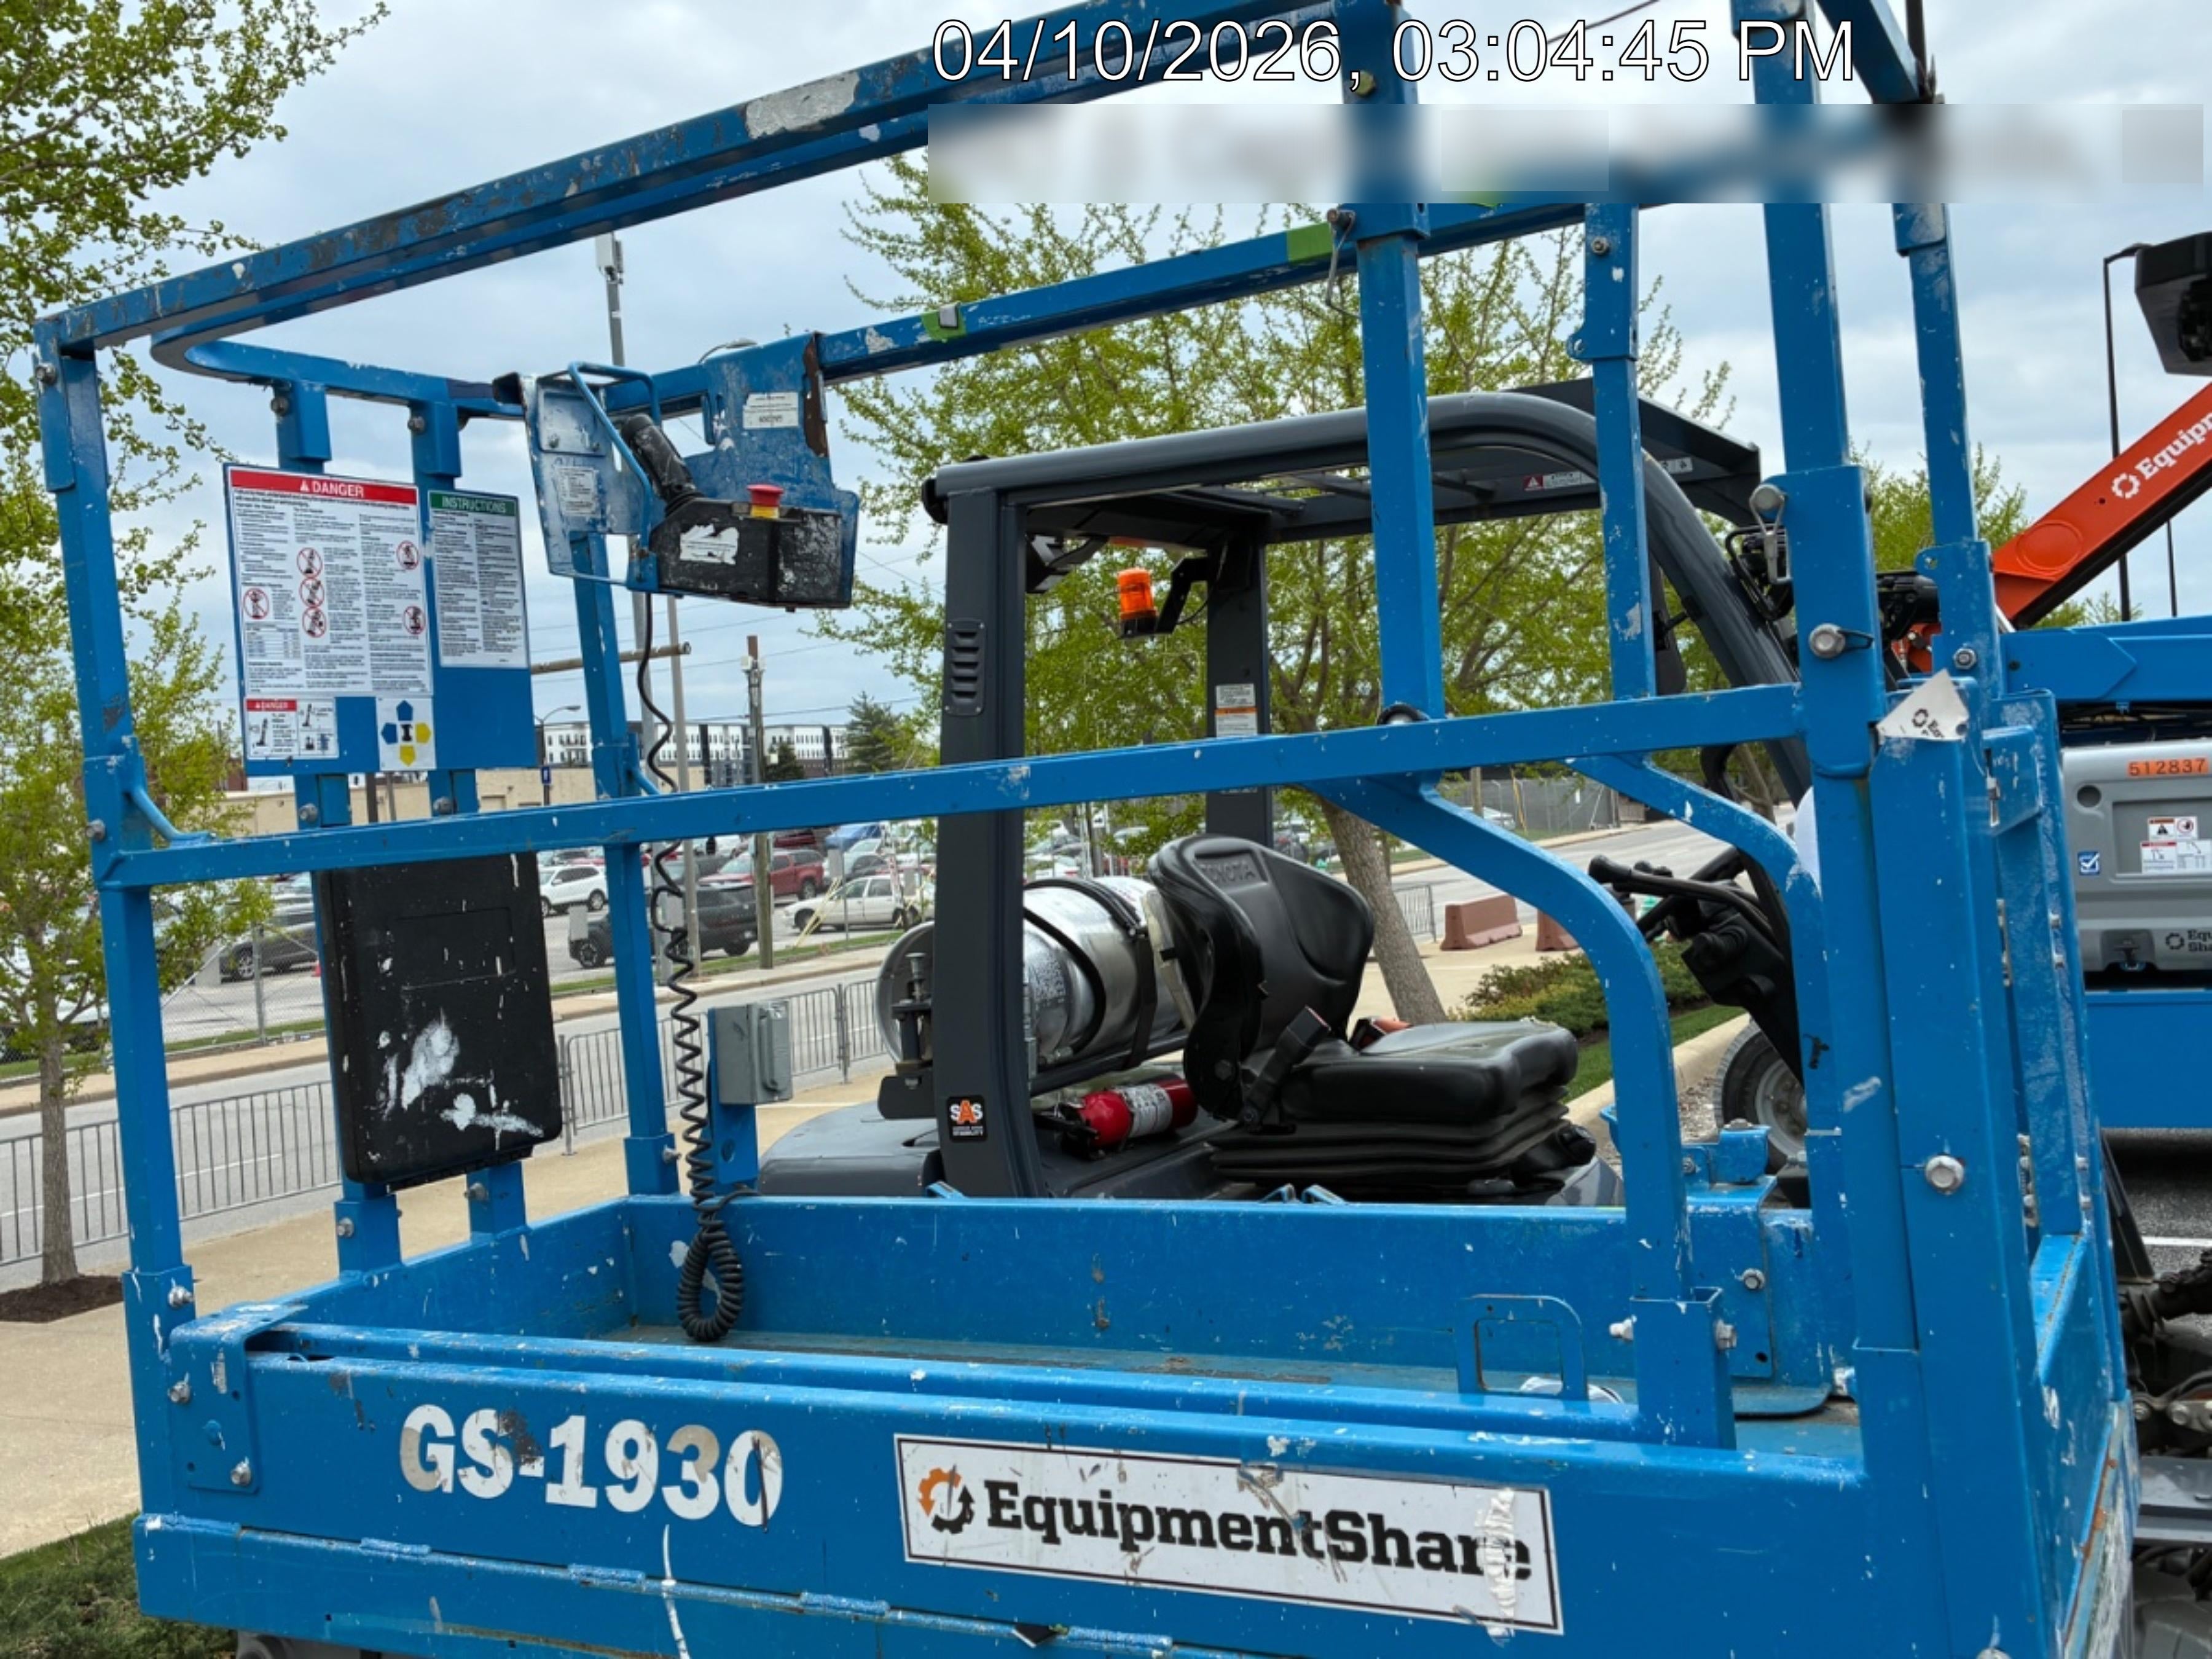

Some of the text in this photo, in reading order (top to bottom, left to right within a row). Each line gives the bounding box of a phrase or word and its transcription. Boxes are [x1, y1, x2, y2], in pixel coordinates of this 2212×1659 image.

[312, 480, 364, 498] DANGER
[442, 496, 506, 512] INSTRUCTIONS
[2129, 758, 2205, 776] 512837
[950, 1099, 983, 1125] SAS
[400, 1404, 783, 1527] GS-1930
[984, 1478, 1532, 1580] EquipmentShare
